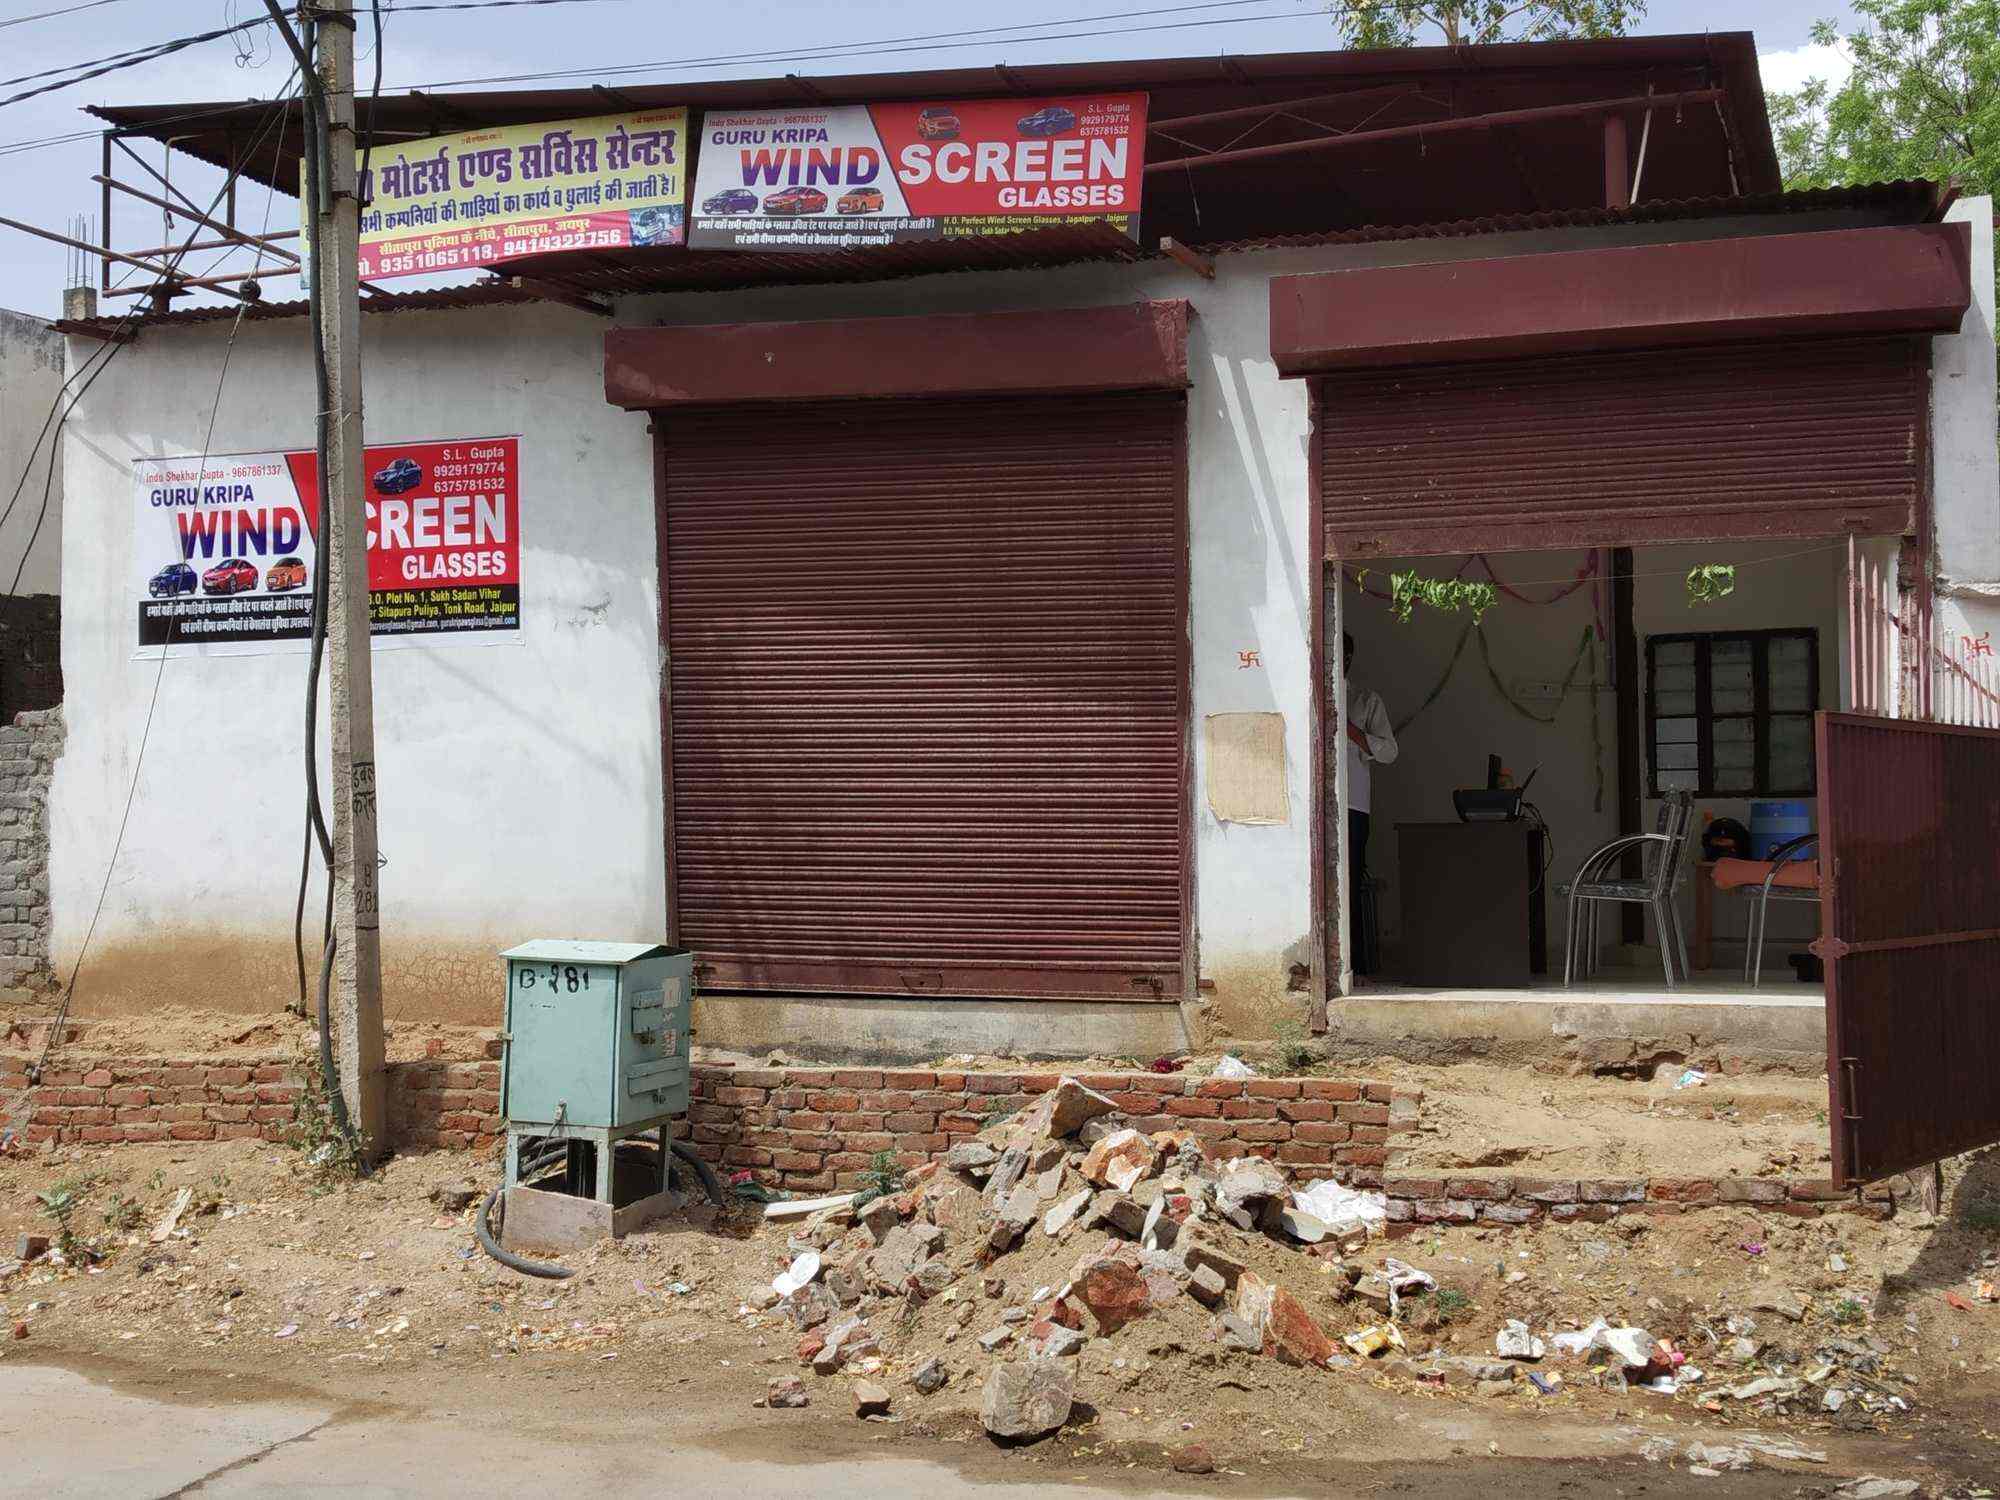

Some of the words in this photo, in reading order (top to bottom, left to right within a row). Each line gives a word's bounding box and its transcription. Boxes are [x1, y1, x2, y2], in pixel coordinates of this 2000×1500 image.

[1106, 103, 1130, 113] Gupta
[1081, 114, 1129, 125] 9929179774
[712, 130, 766, 145] GURU
[771, 128, 829, 143] KRIPA
[1080, 125, 1129, 136] 6375781532
[381, 146, 451, 199] मोटर्स
[457, 148, 512, 188] एण्ड
[519, 129, 599, 180] सर्विस
[605, 124, 676, 170] सेन्टर
[740, 146, 880, 187] WIND
[899, 138, 1128, 185] SCREEN
[441, 199, 457, 221] की
[503, 193, 520, 213] का
[524, 185, 550, 209] कार्य
[554, 190, 562, 206] व
[566, 180, 600, 212] धुलाई
[605, 178, 621, 201] की
[625, 175, 658, 198] जाती
[998, 184, 1125, 208] GLASSES
[961, 216, 986, 224] Perfect
[988, 215, 1006, 224] Wind
[1007, 216, 1031, 224] Screen
[1105, 214, 1128, 223] Jaipur
[424, 235, 459, 252] पुलिया
[461, 231, 473, 244] के
[555, 218, 590, 234] जयपुर
[504, 229, 621, 256] 9414322756
[443, 449, 466, 460] S.L.
[470, 447, 505, 460] Gupta
[201, 468, 224, 480] Gupta
[231, 464, 282, 479] 9667861337
[433, 462, 505, 477] 9929179774
[433, 478, 505, 493] 6375781532
[150, 487, 198, 507] GURU
[204, 484, 254, 504] KRIPA
[177, 506, 301, 560] WIND
[402, 551, 507, 581] GLASSES
[386, 592, 401, 604] Plot
[404, 591, 417, 603] No.
[430, 590, 450, 602] Sukh
[452, 589, 478, 600] Sadan
[479, 587, 501, 599] Vihar
[379, 606, 411, 619] Sitapura
[414, 604, 441, 618] Puliya,
[444, 602, 462, 614] Tonk
[490, 601, 516, 614] Jaipur
[356, 889, 378, 913] 281
